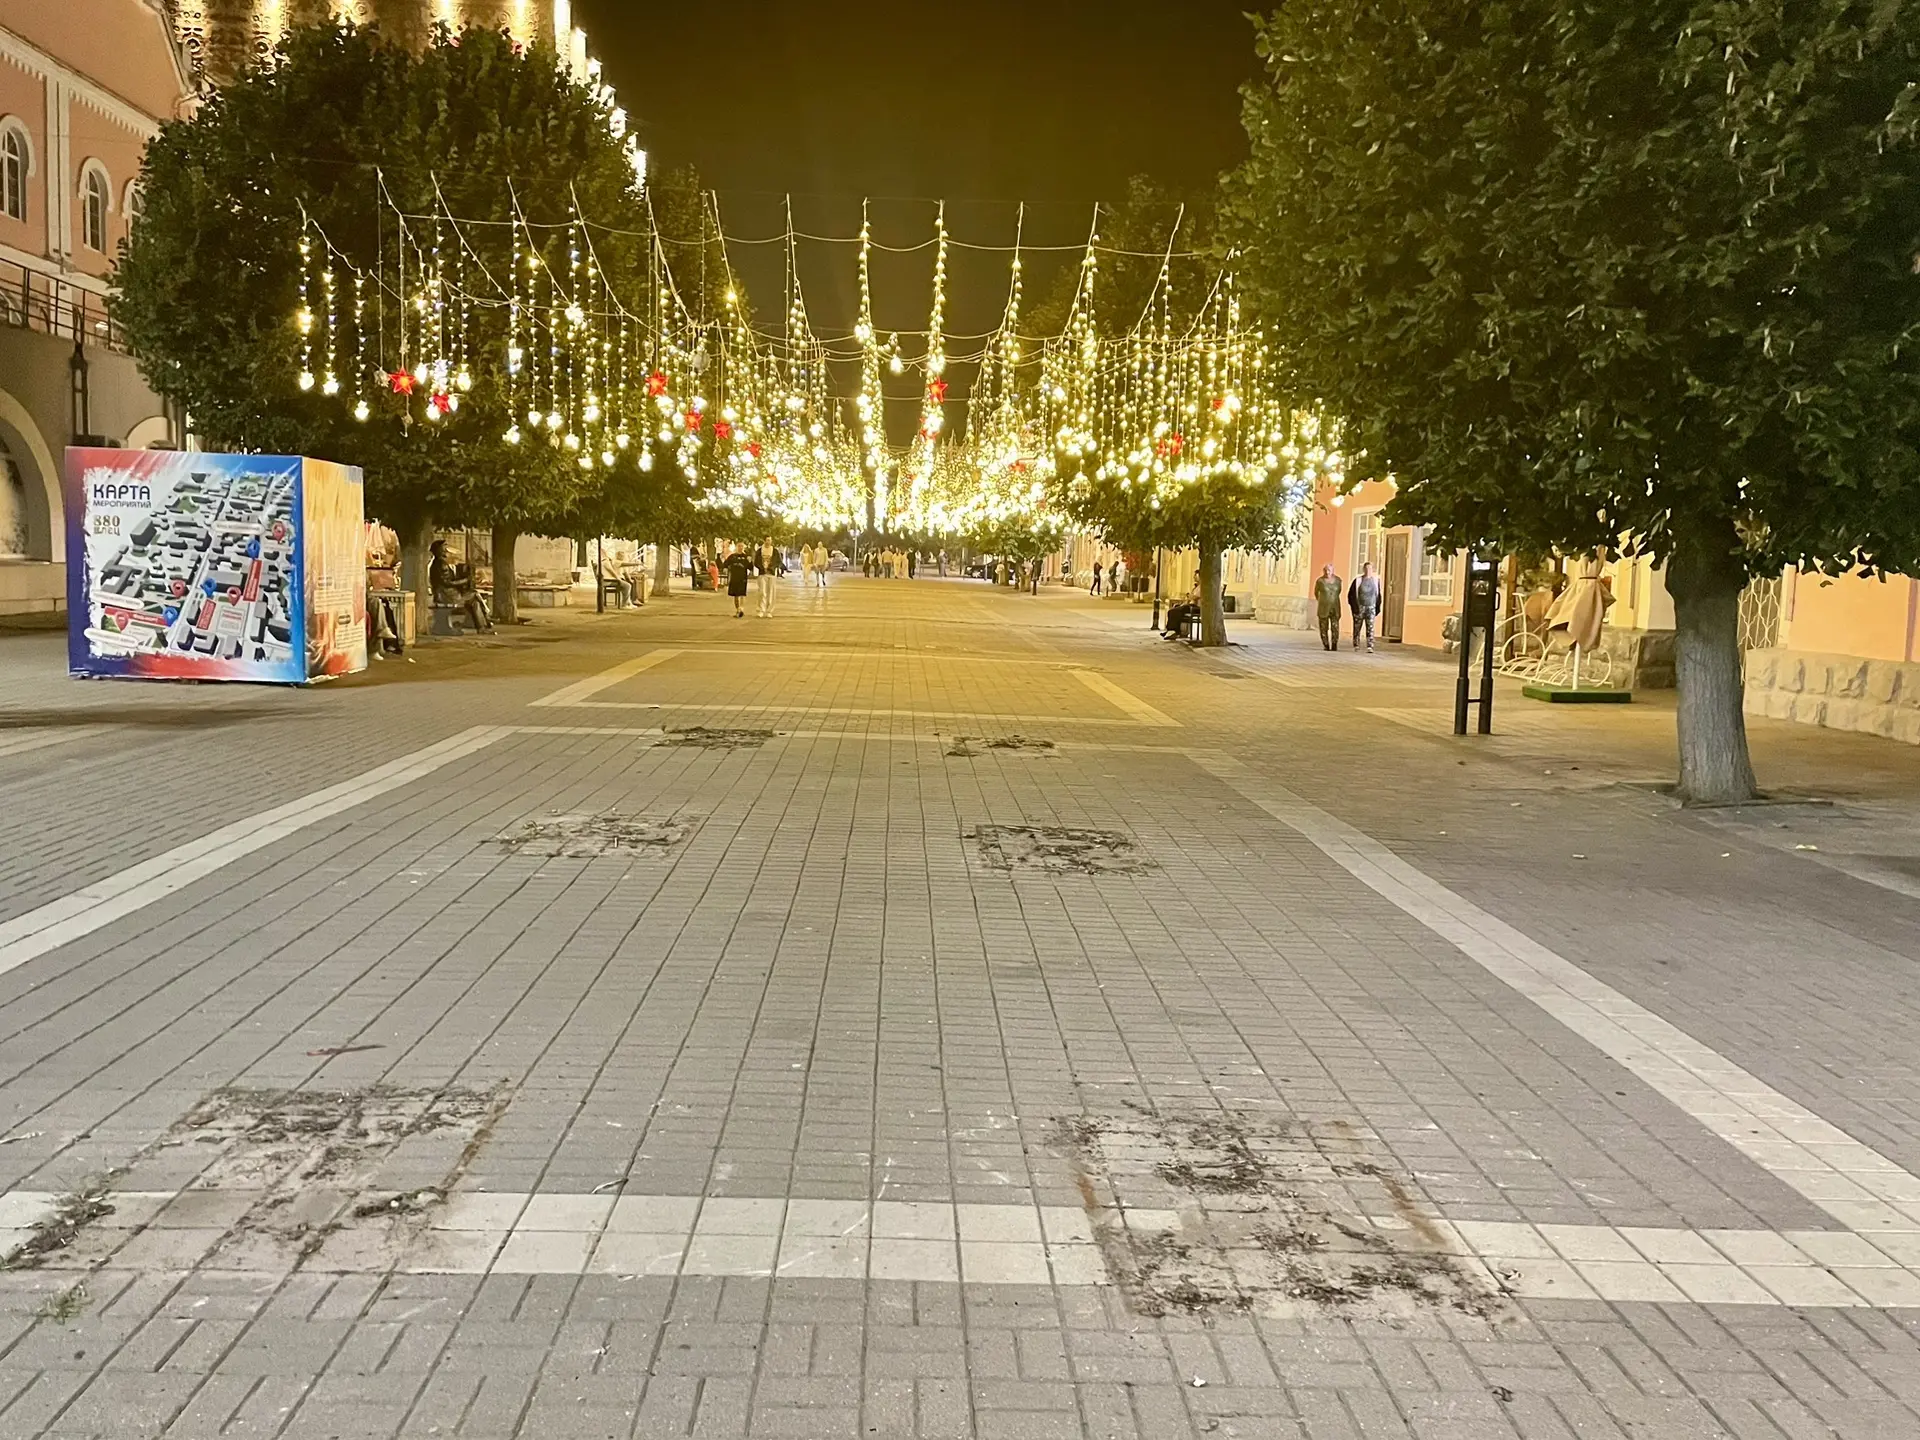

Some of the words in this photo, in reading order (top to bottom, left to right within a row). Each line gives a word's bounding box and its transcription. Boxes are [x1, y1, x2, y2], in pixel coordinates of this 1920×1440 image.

[93, 484, 151, 500] КАРТА
[93, 500, 152, 508] МЕРОПРИЯТИЙ
[93, 514, 121, 527] 880
